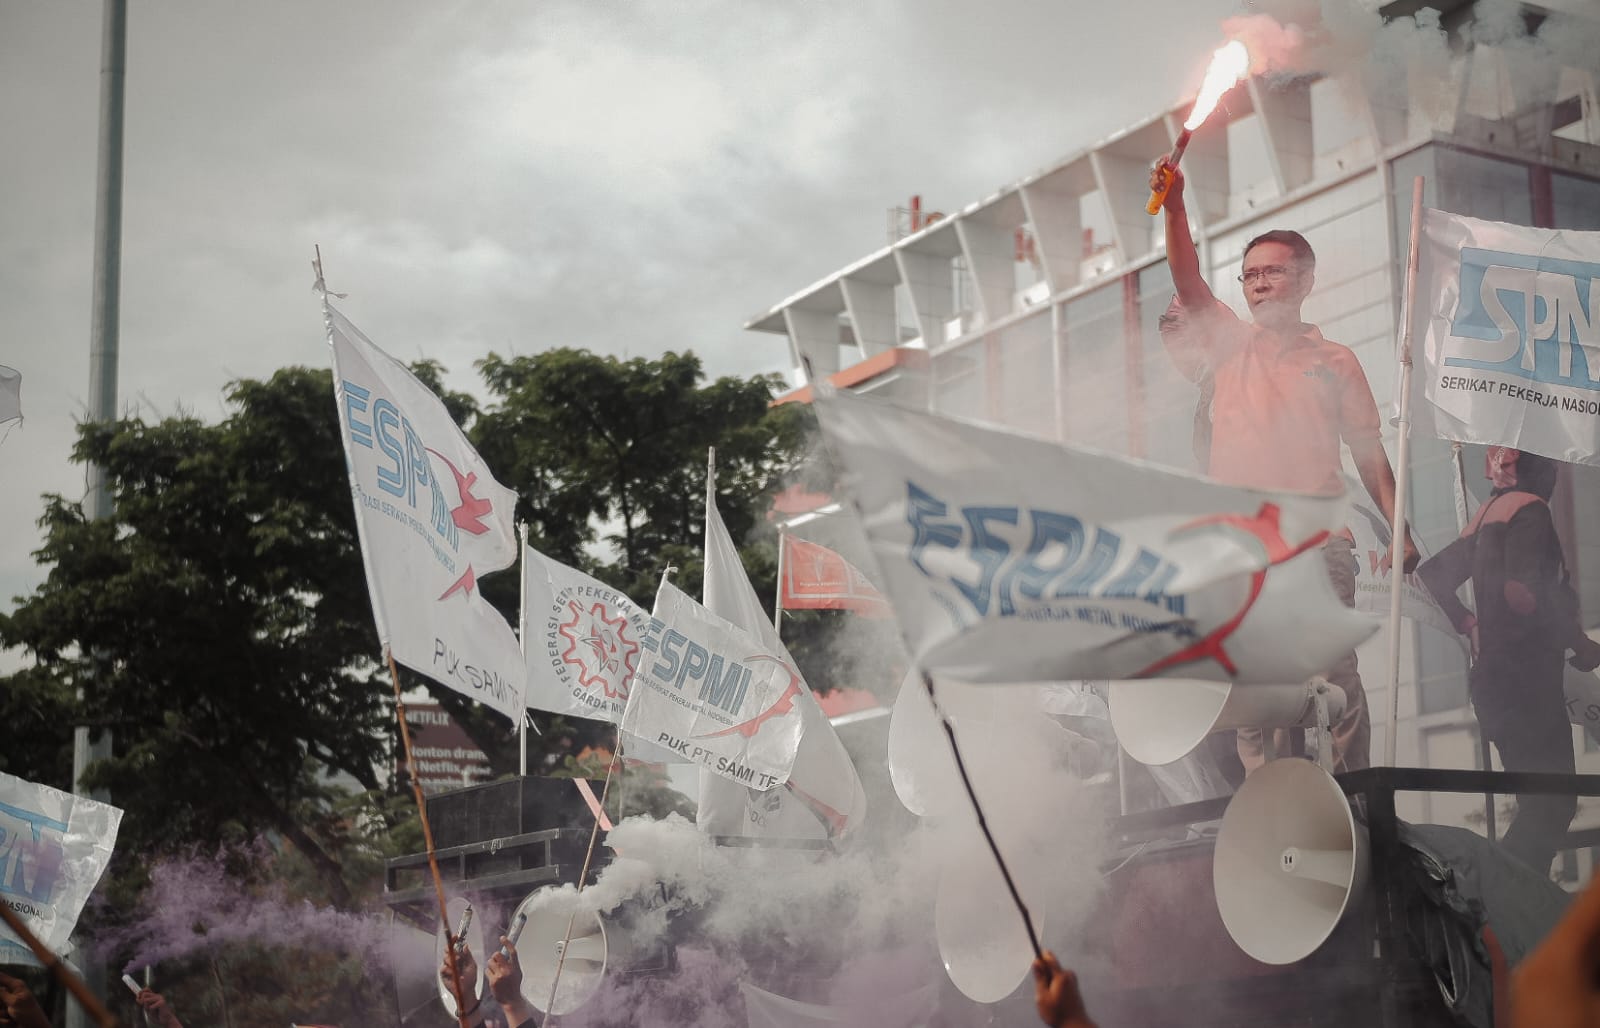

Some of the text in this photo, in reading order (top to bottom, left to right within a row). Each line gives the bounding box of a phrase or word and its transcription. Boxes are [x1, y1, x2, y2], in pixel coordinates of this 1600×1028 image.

[1440, 376, 1600, 415] SERIKAT PEKERJA NASIO
[547, 616, 571, 684] FEDERASI
[577, 585, 632, 614] PEKERJA
[433, 638, 466, 684] PUK
[405, 710, 449, 726] NETFLIX
[573, 687, 608, 710] GARDA
[657, 732, 691, 756] PUK
[691, 746, 714, 766] PT.
[716, 756, 755, 783] SAMI
